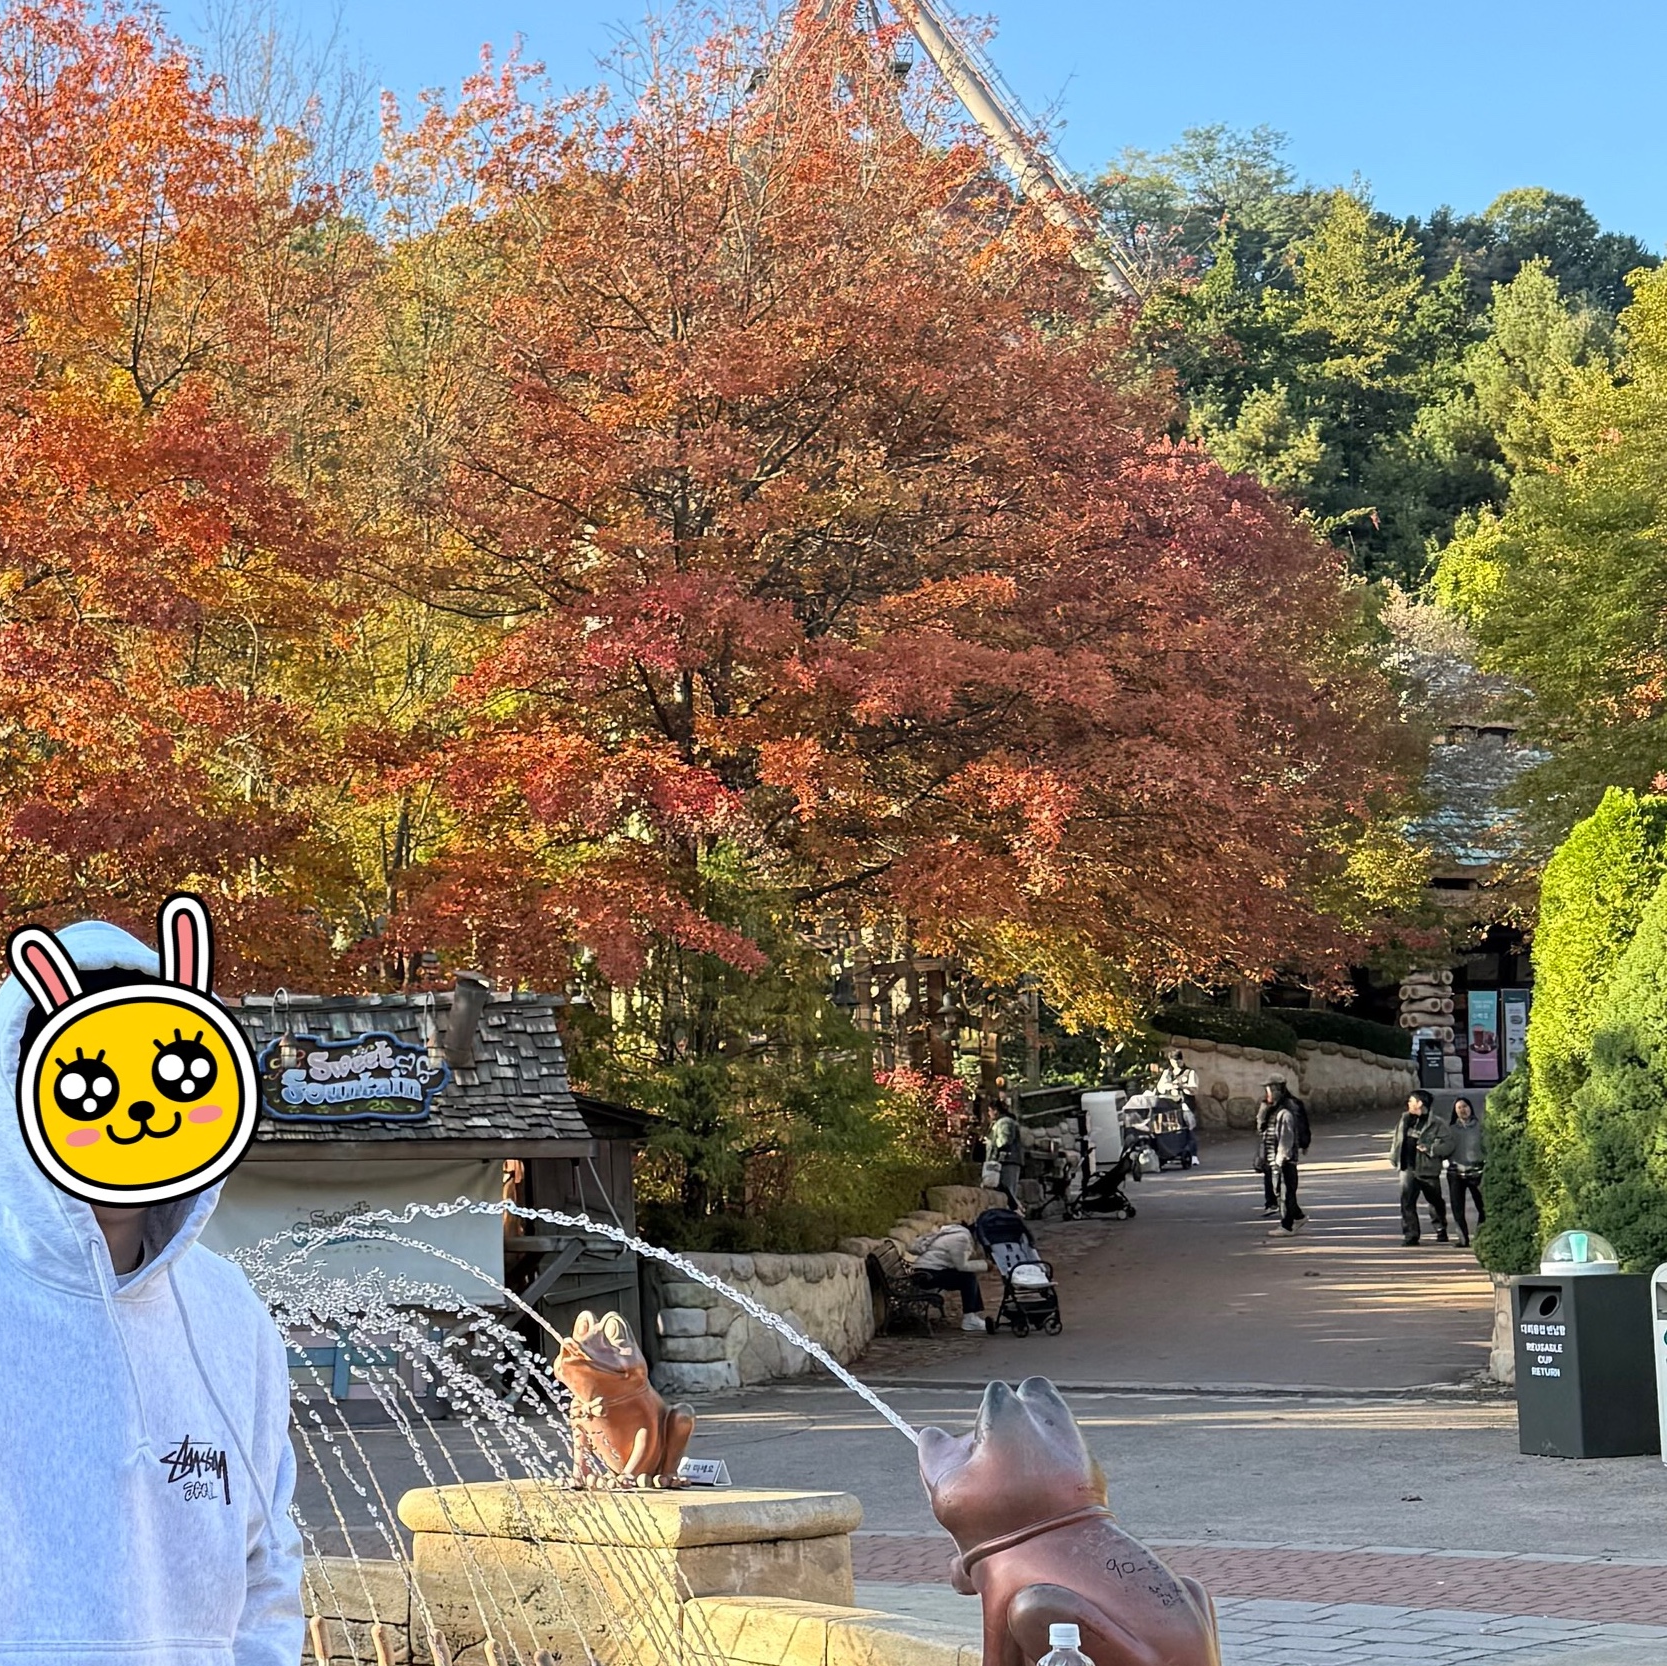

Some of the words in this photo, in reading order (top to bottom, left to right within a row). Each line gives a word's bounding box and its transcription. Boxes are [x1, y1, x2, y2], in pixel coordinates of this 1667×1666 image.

[307, 1040, 395, 1081] Sweet
[281, 1069, 423, 1105] Fountain
[1525, 1342, 1564, 1353] REUSABLE
[1537, 1355, 1553, 1364] CUP
[1531, 1366, 1561, 1377] RETURN
